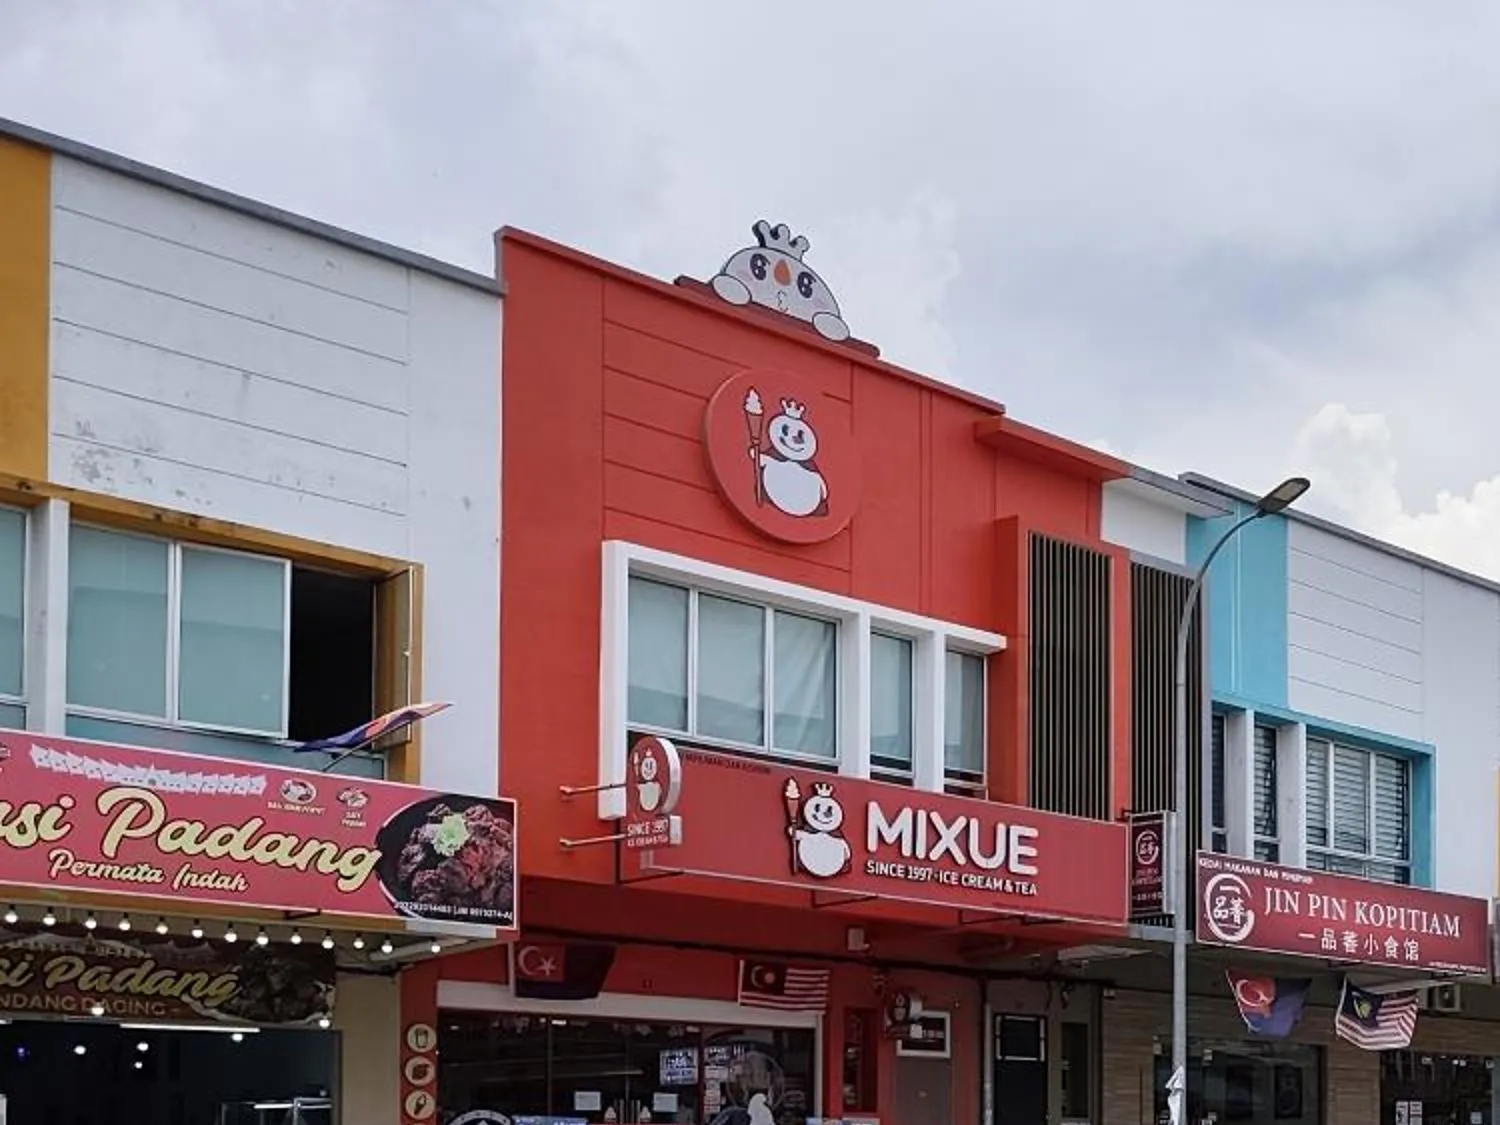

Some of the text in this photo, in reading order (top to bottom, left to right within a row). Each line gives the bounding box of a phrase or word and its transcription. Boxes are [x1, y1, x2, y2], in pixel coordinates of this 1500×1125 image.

[97, 785, 382, 892] Padang
[867, 801, 1039, 875] MIXUE
[49, 849, 249, 893] Permata Indah
[867, 860, 905, 877] SINCE
[907, 866, 932, 881] 1997
[1264, 887, 1460, 938] JIN PIN KOPITIAM
[43, 955, 241, 1007] Padang
